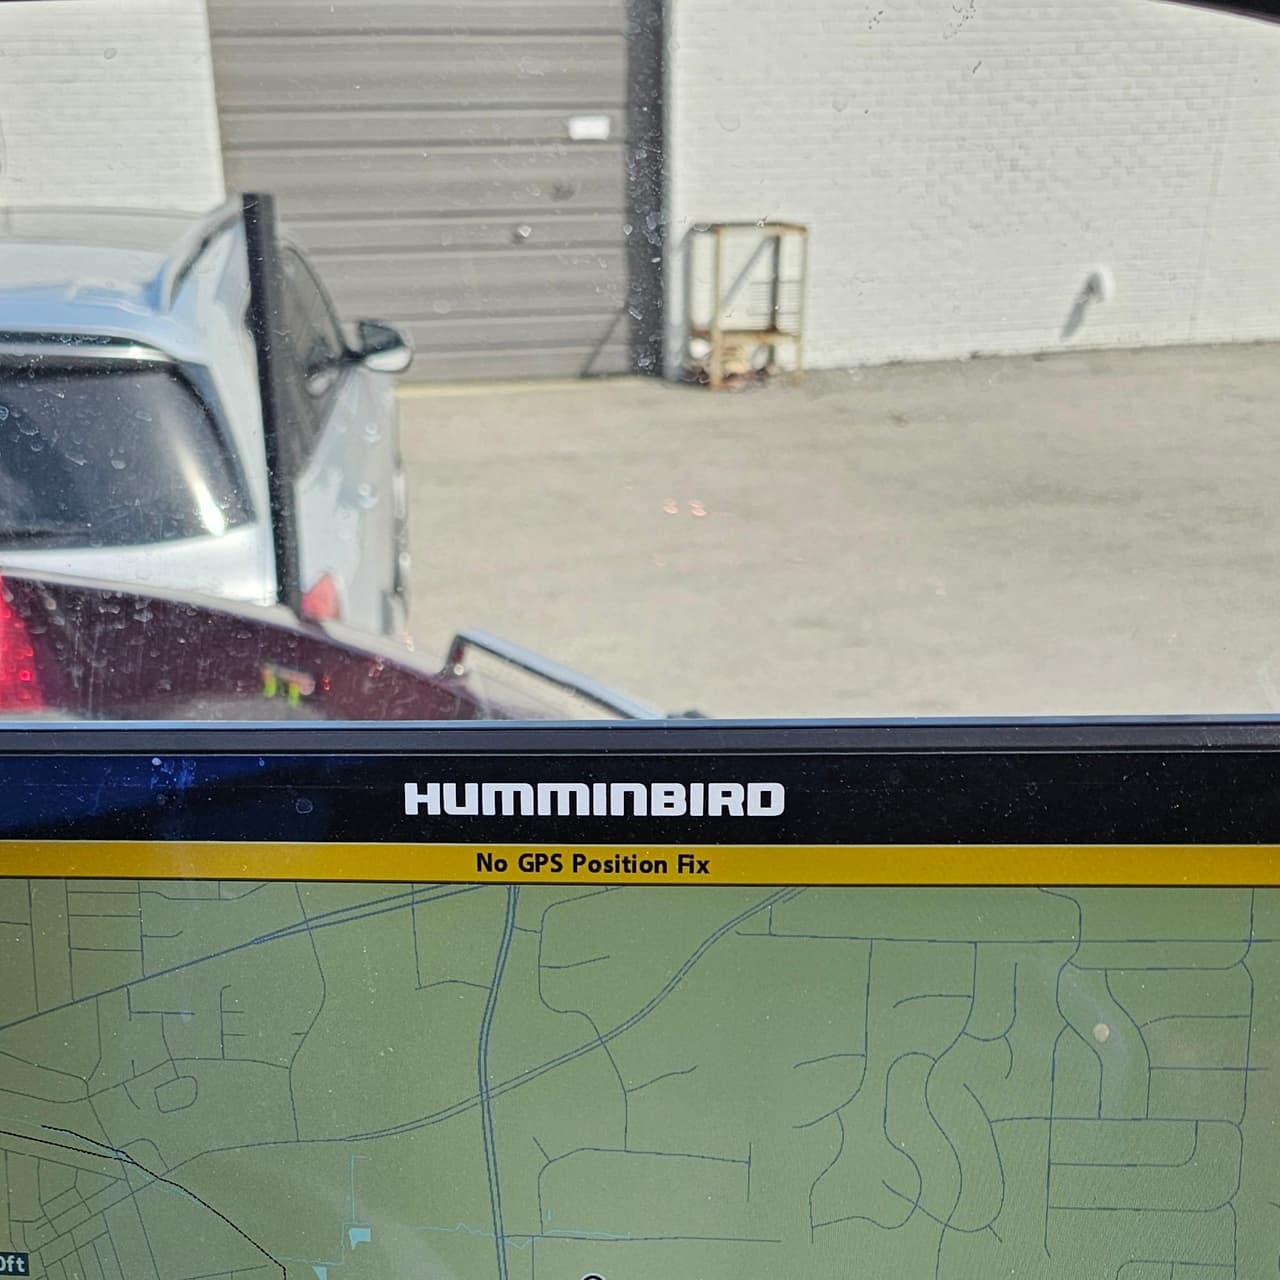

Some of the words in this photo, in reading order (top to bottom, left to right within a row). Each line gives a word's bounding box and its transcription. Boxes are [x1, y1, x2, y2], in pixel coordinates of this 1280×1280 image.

[404, 782, 785, 817] HUMMINBIRD
[476, 852, 508, 874] No
[518, 853, 563, 874] GPS
[573, 853, 668, 874] Position
[678, 853, 710, 875] Fix
